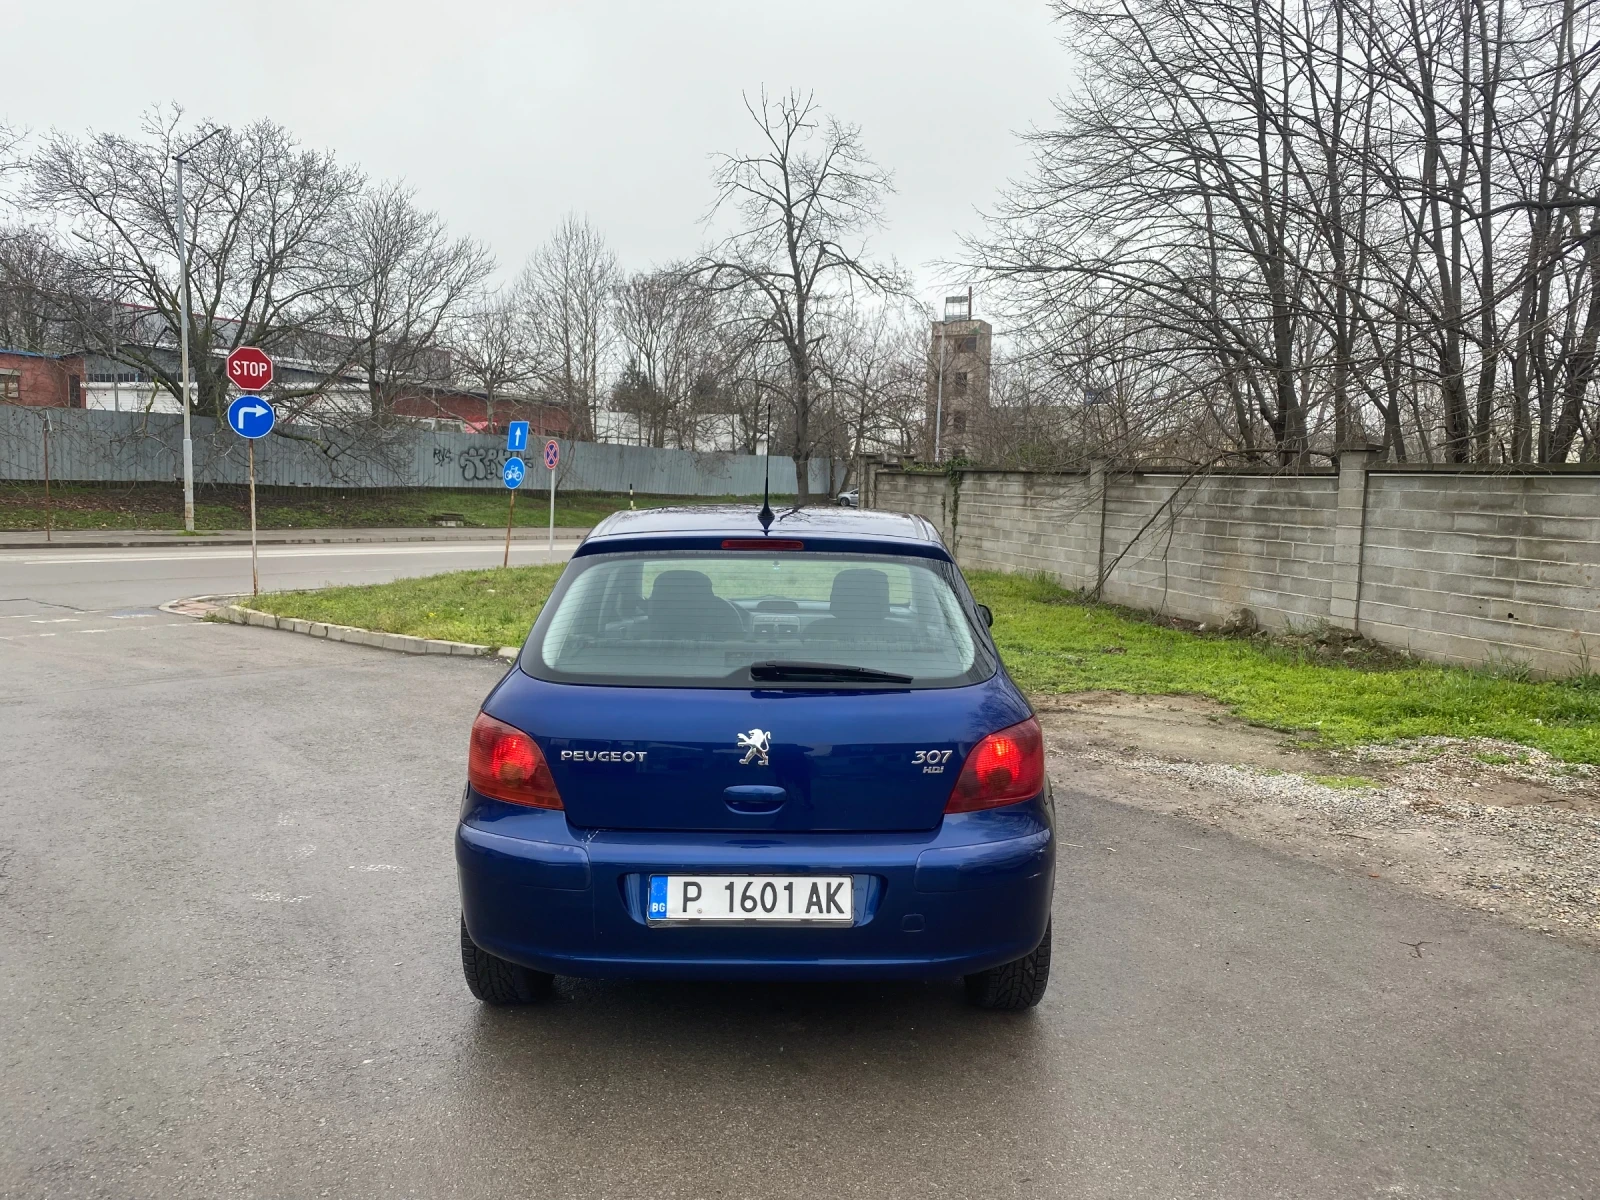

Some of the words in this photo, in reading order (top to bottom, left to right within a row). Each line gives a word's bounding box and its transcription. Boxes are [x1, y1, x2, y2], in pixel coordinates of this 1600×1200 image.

[233, 360, 267, 377] STOP
[560, 750, 648, 762] PEUGEOT
[911, 750, 953, 764] 307
[682, 881, 702, 913] P
[724, 881, 793, 913] 1601
[805, 882, 844, 914] AK
[652, 903, 665, 912] BG
